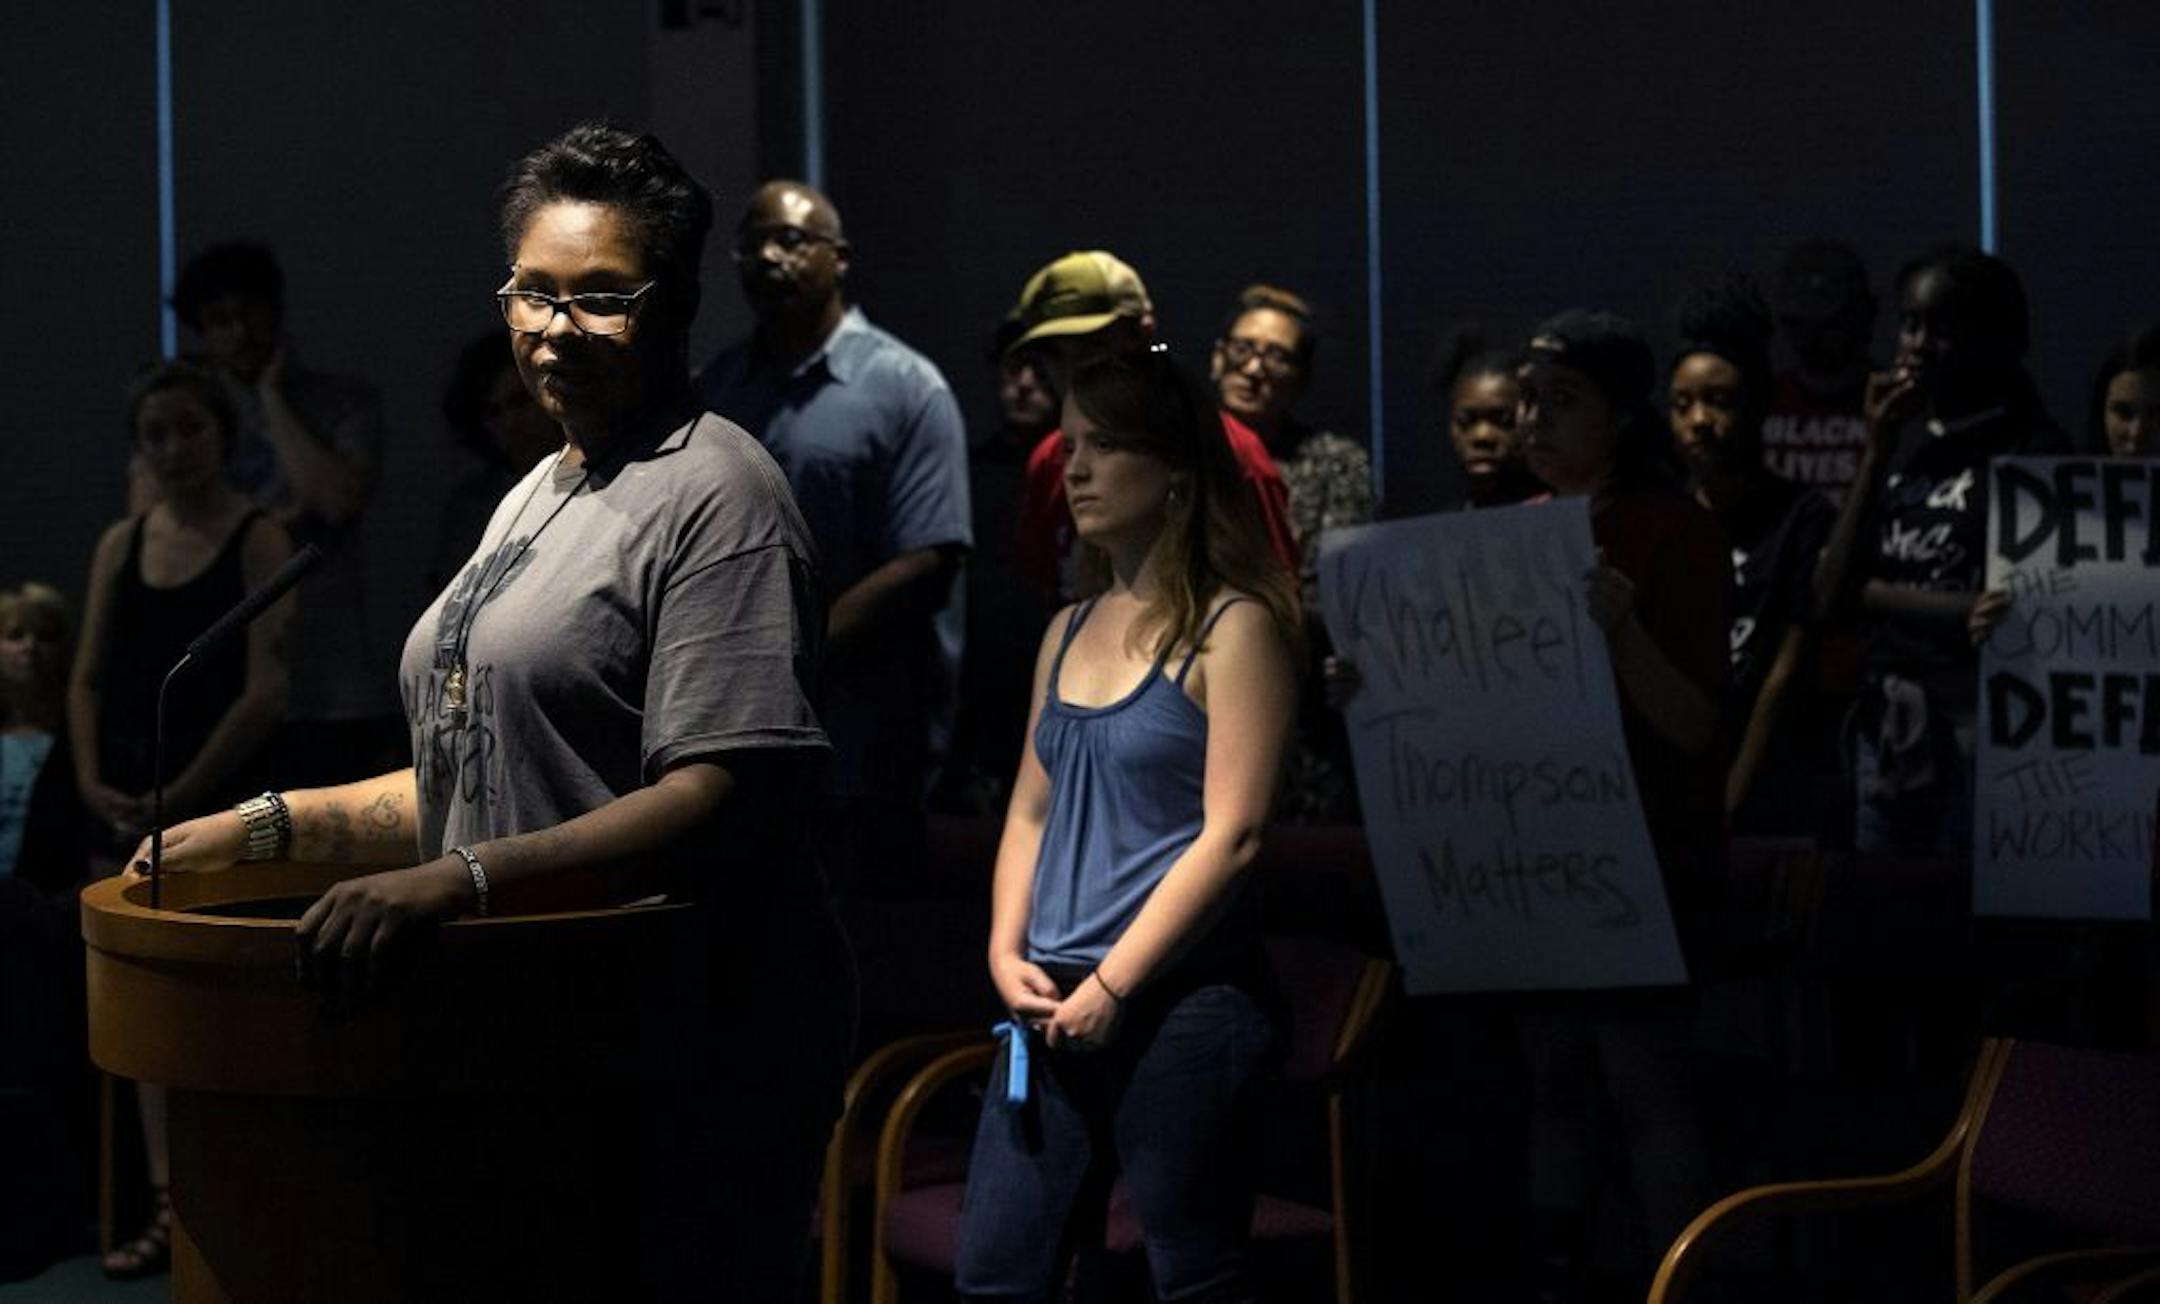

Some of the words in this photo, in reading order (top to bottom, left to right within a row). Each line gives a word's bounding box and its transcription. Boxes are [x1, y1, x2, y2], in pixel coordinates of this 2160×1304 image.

[2002, 567, 2078, 600] THE
[1335, 552, 1588, 700] Khaleel
[1991, 752, 2096, 802] THE
